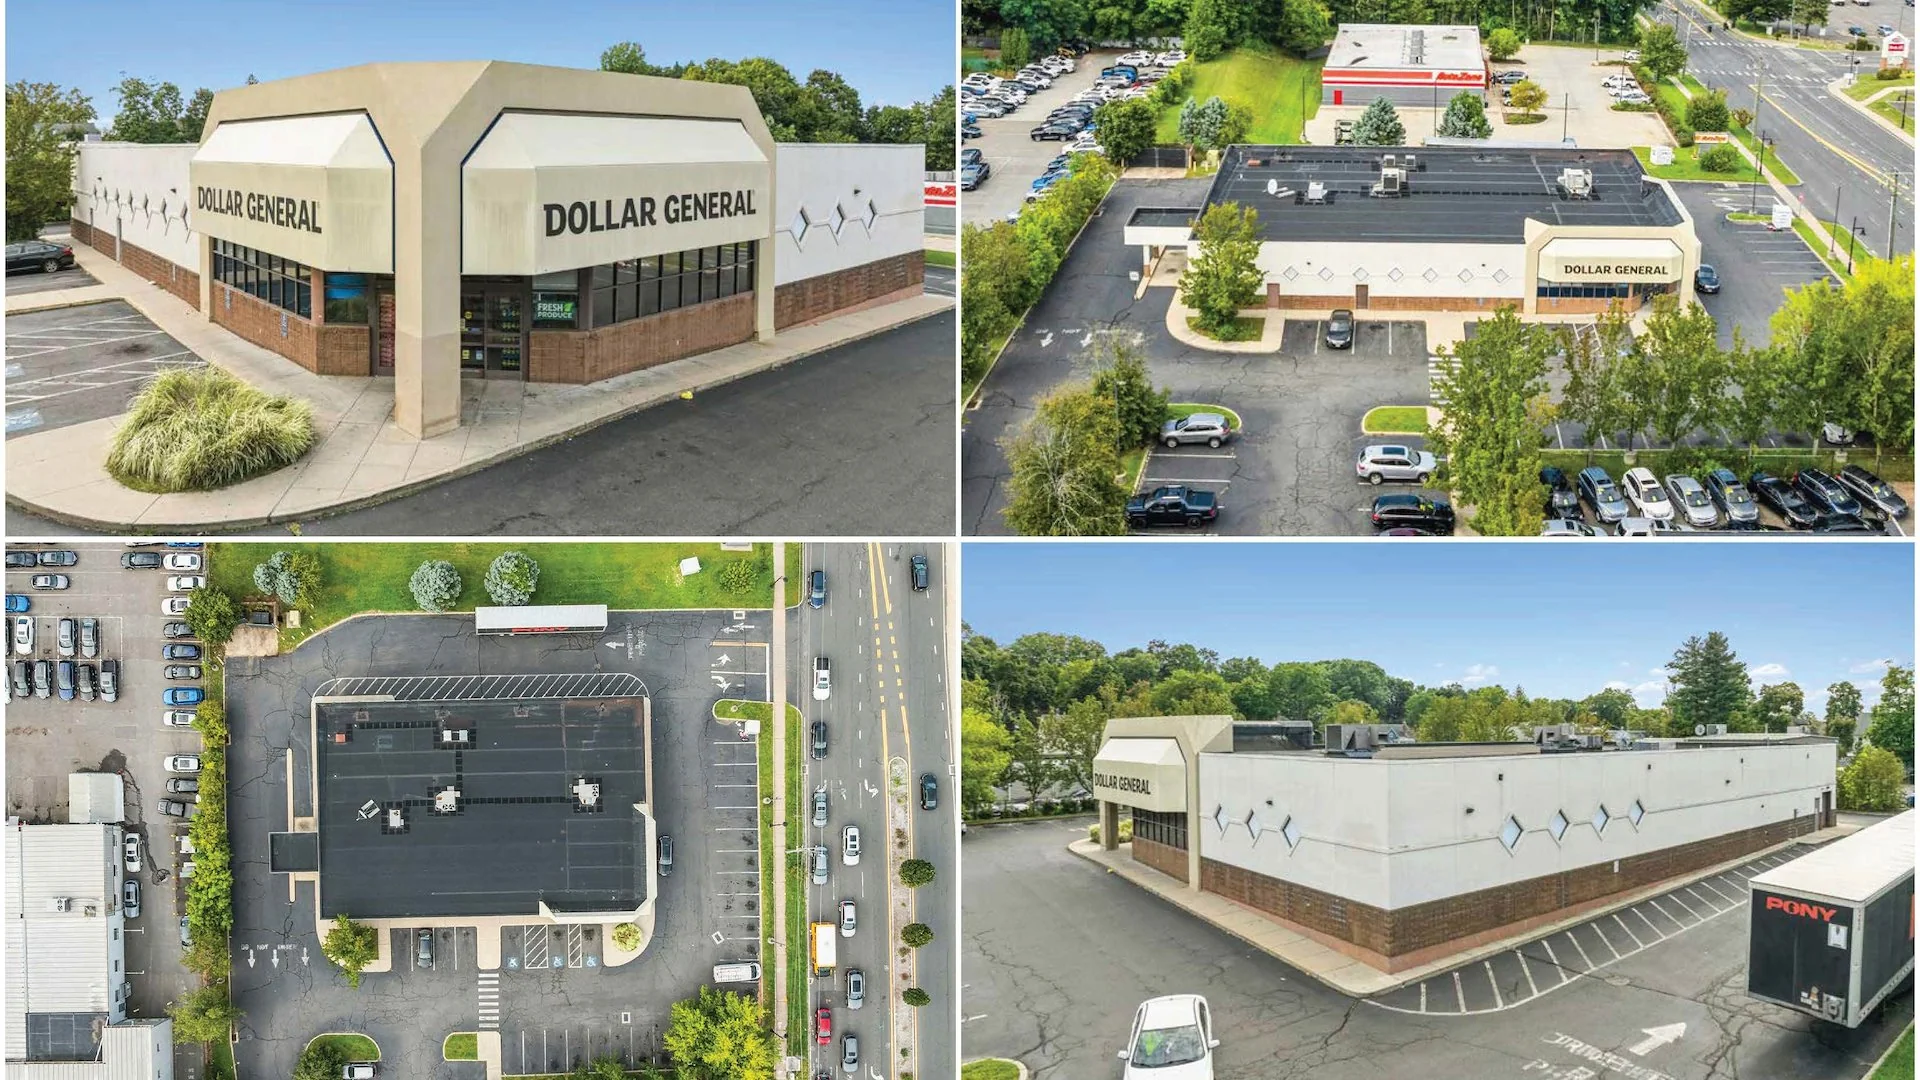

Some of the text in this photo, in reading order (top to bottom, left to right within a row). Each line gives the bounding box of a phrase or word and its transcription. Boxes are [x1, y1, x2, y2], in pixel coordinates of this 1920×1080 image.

[198, 186, 322, 234] DOLLAR GENERAL
[544, 190, 757, 237] DOLLAR GENERAL
[1564, 265, 1668, 275] DOLLAR GENERAL
[537, 303, 563, 312] FRESH
[1094, 772, 1151, 795] DOLLAR GENERAL
[1766, 897, 1837, 922] PONY
